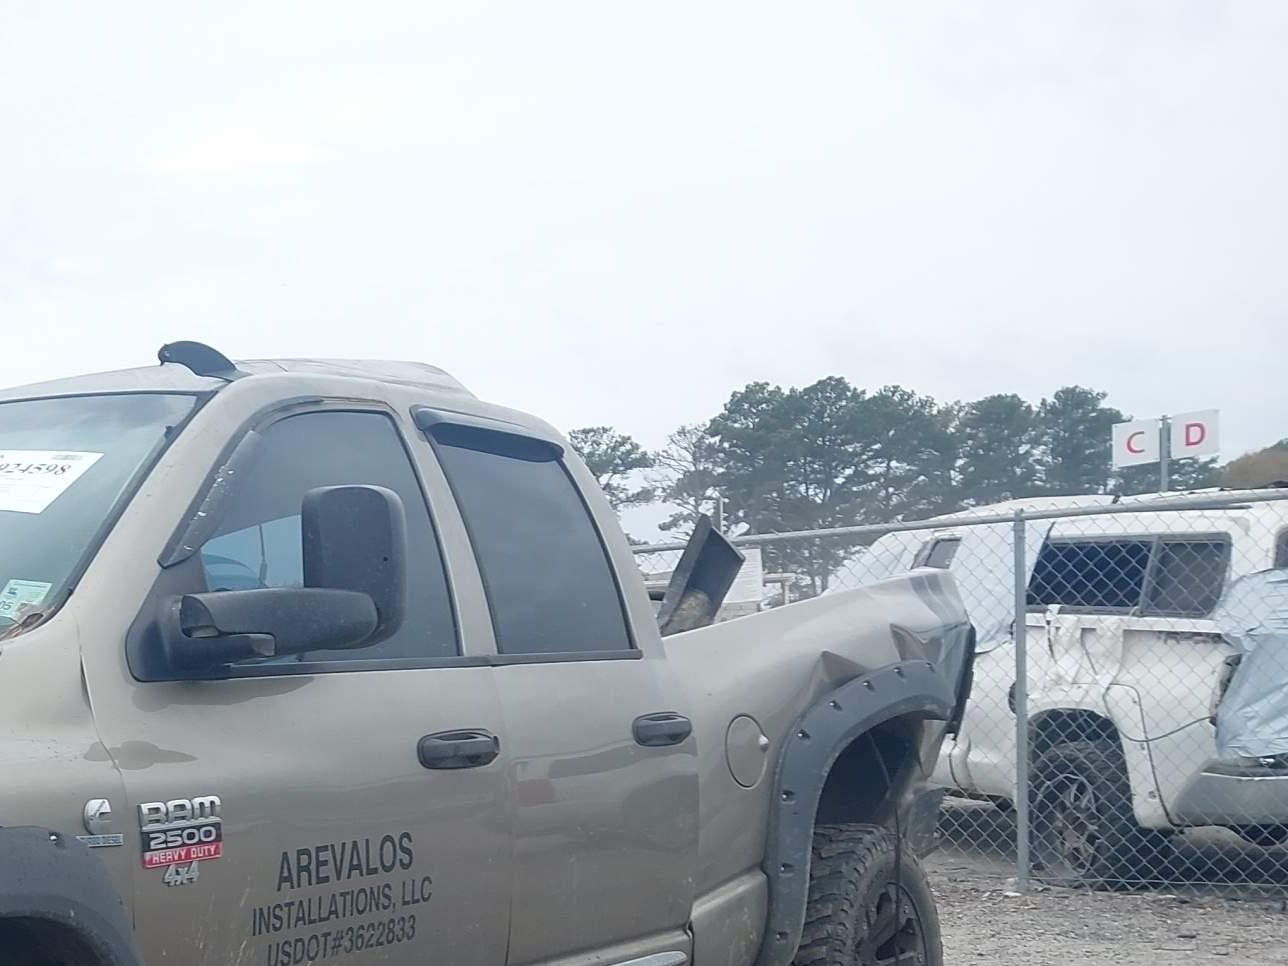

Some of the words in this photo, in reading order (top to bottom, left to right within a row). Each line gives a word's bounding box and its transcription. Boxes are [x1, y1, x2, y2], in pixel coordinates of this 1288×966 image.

[1127, 431, 1145, 453] C
[1185, 423, 1206, 447] D
[139, 796, 222, 831] RAM
[149, 826, 217, 850] 2500
[152, 850, 187, 864] HEAVY
[191, 845, 216, 858] DUTY
[277, 832, 413, 892] AREVALOS
[164, 860, 201, 887] 4x4
[252, 883, 396, 936] INSTALLATIONS,
[402, 876, 432, 906] LLC
